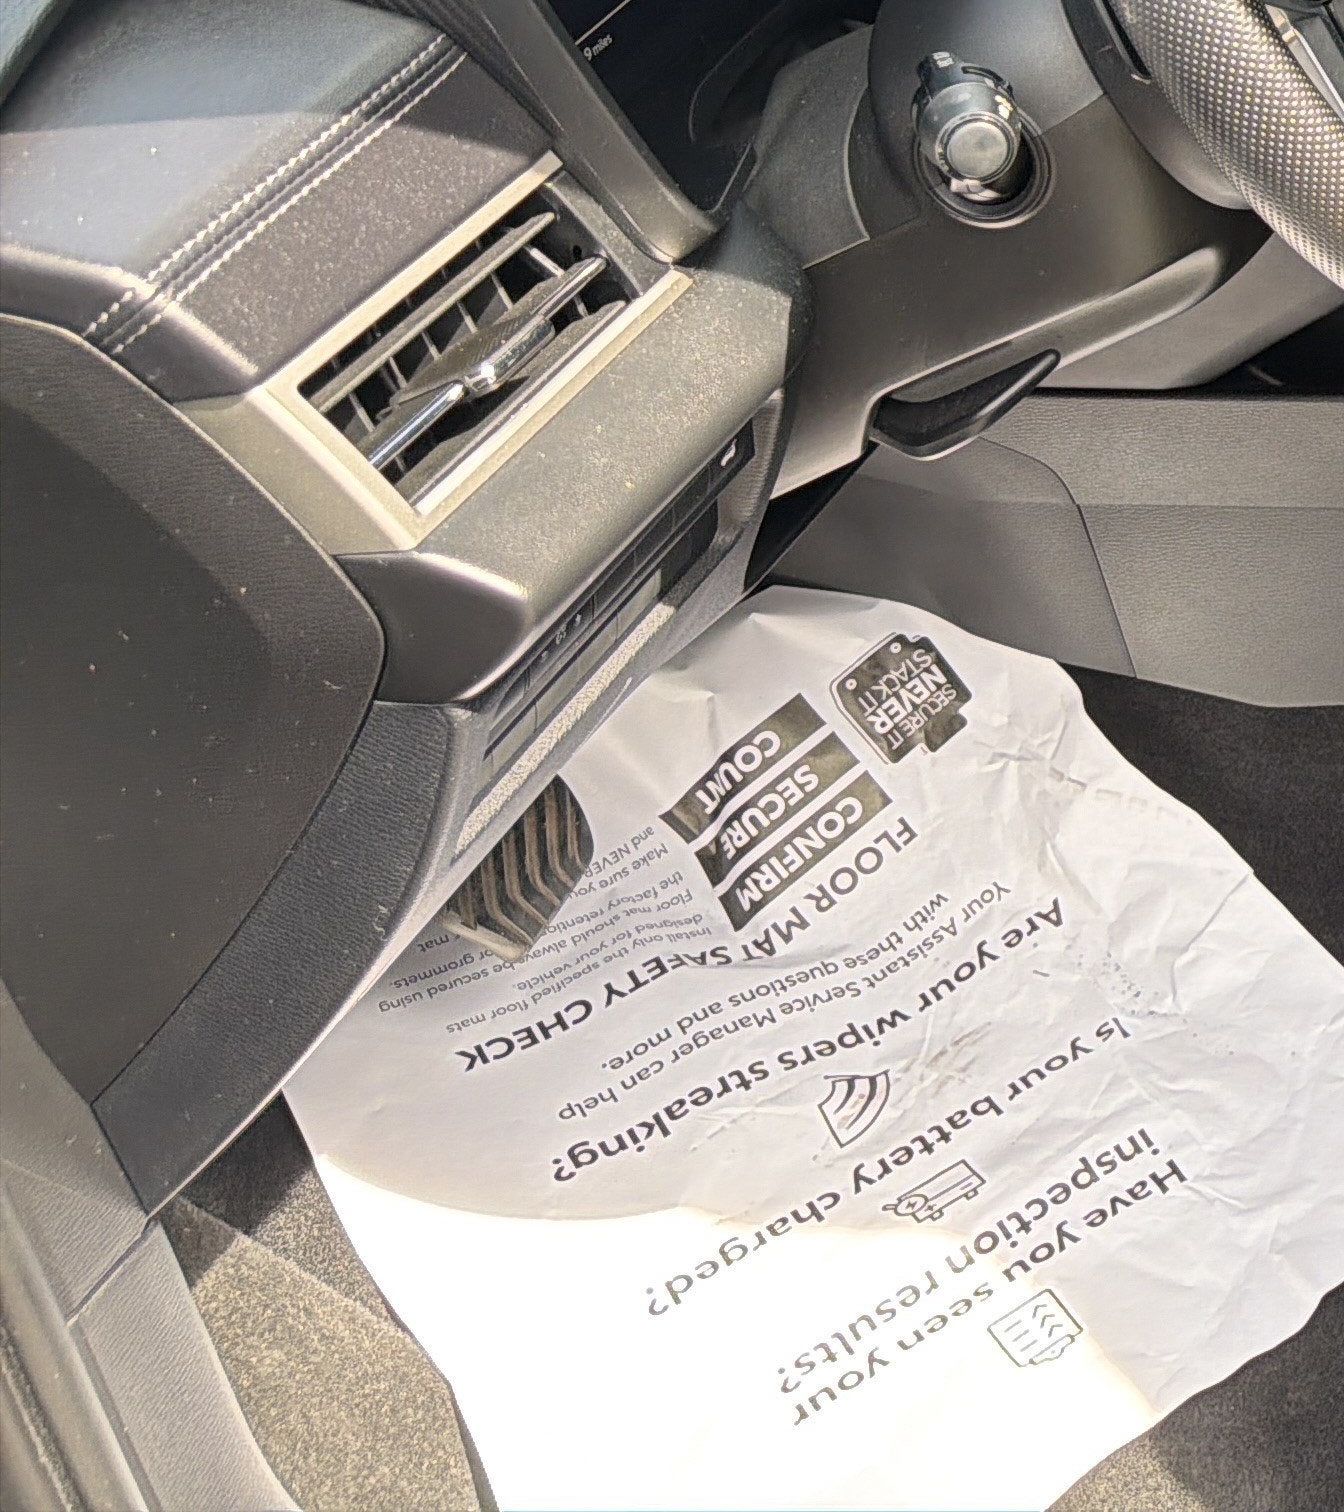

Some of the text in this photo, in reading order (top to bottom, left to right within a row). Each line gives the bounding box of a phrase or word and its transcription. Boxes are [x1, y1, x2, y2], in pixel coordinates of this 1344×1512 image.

[858, 648, 932, 716] STACK IT
[866, 663, 947, 734] NEVER
[887, 683, 957, 750] SECURE IT
[695, 730, 781, 814] COUNT
[630, 826, 655, 850] and
[720, 764, 819, 860] SECURE
[599, 867, 630, 889] sure
[632, 843, 668, 871] Make
[659, 871, 683, 890] the
[734, 796, 863, 912] CONFIRM
[571, 913, 620, 946] should
[608, 886, 658, 911] factory
[622, 905, 652, 917] mat
[656, 888, 693, 912] Floor
[390, 952, 475, 989] grommets.
[417, 934, 450, 953] mat
[454, 817, 918, 1072] FLOOR MAT SAFETY CHECK
[493, 959, 515, 974] be
[513, 913, 703, 992] designed for your vehicle.
[378, 990, 423, 1012] using
[426, 968, 489, 999] secured
[445, 927, 712, 1035] Install only the specified floor mats
[558, 881, 1011, 1121] Your Assistant Service Manager can help
[601, 893, 949, 1072] with these questions and more.
[550, 898, 1065, 1182] Are your wipers streaking?
[646, 1017, 1131, 1316] Is your battery charged?
[778, 1128, 1160, 1394] inspection results?
[794, 1159, 1187, 1426] Have you seen your
